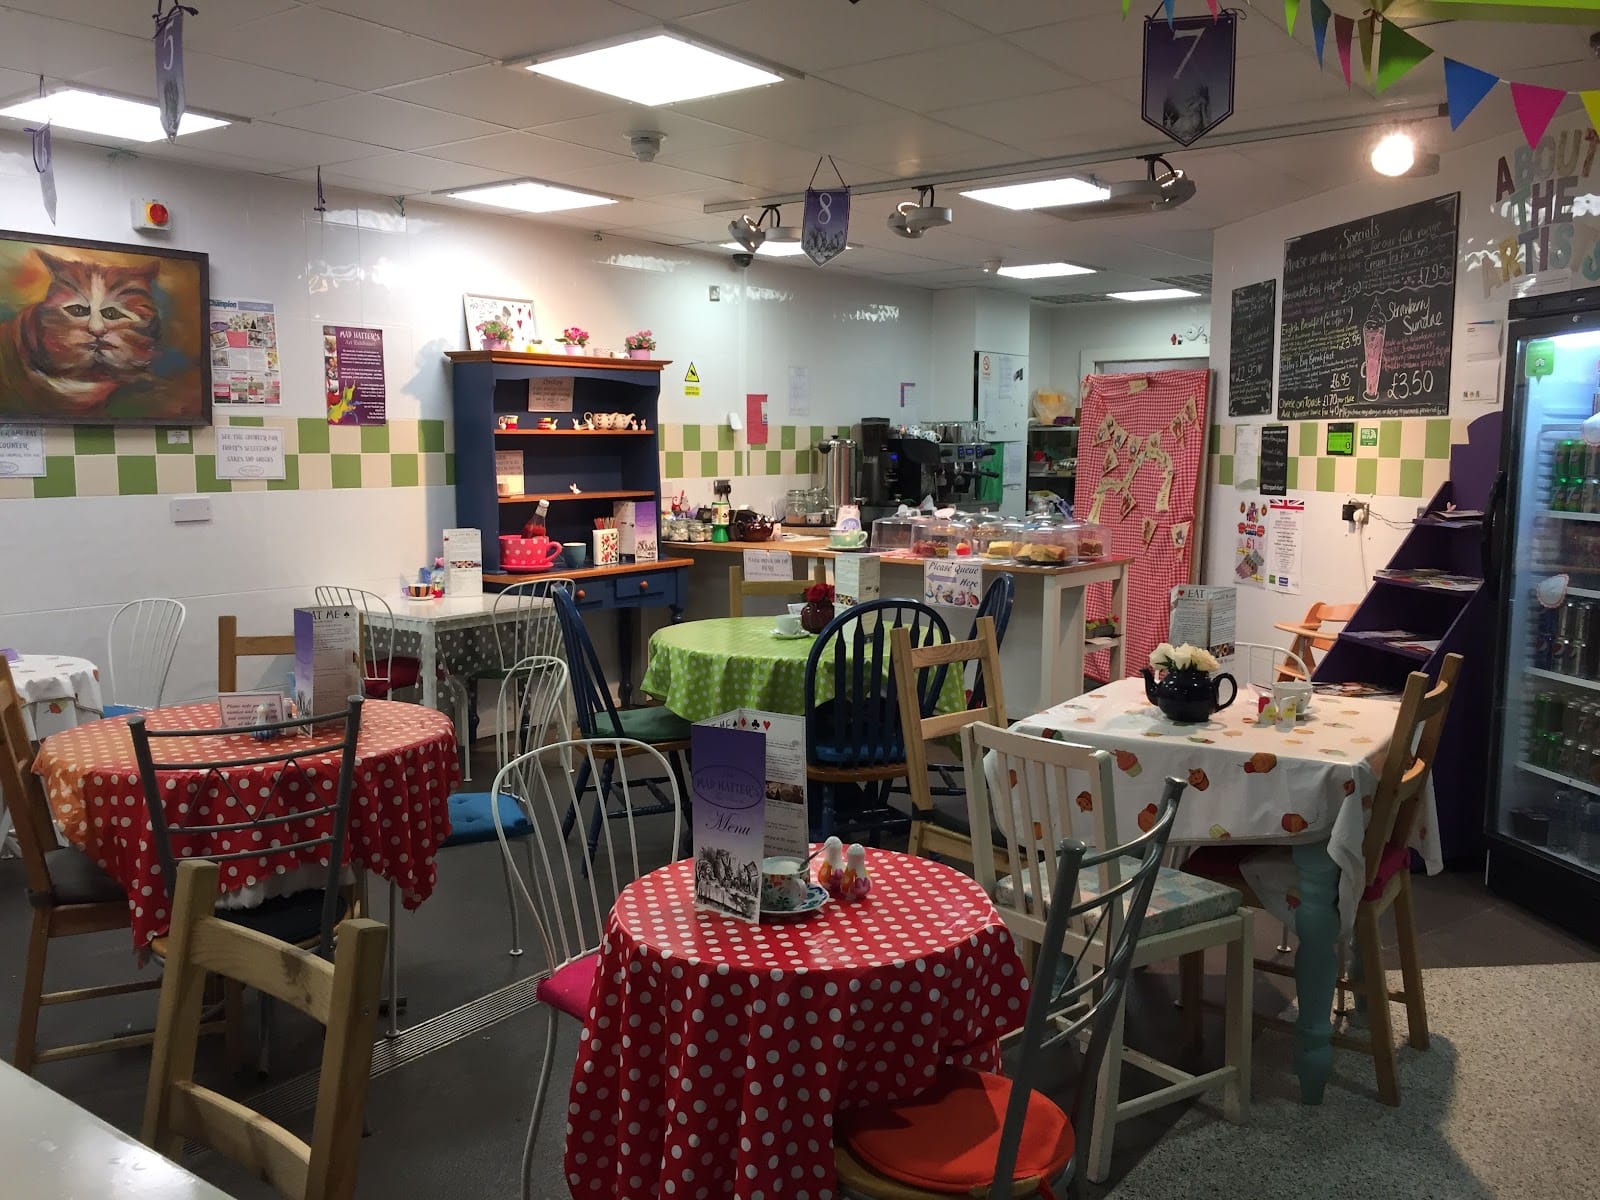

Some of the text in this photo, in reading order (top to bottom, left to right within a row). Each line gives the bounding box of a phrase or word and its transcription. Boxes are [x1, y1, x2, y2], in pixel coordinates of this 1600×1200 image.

[1173, 26, 1207, 79] 7
[817, 192, 832, 225] 8
[1341, 216, 1381, 251] Specials
[1387, 370, 1434, 400] £3.50
[928, 561, 979, 575] Please Queue
[960, 578, 979, 590] Here
[1187, 588, 1206, 599] EAT
[312, 610, 340, 620] AT ME
[705, 810, 751, 836] Menu
